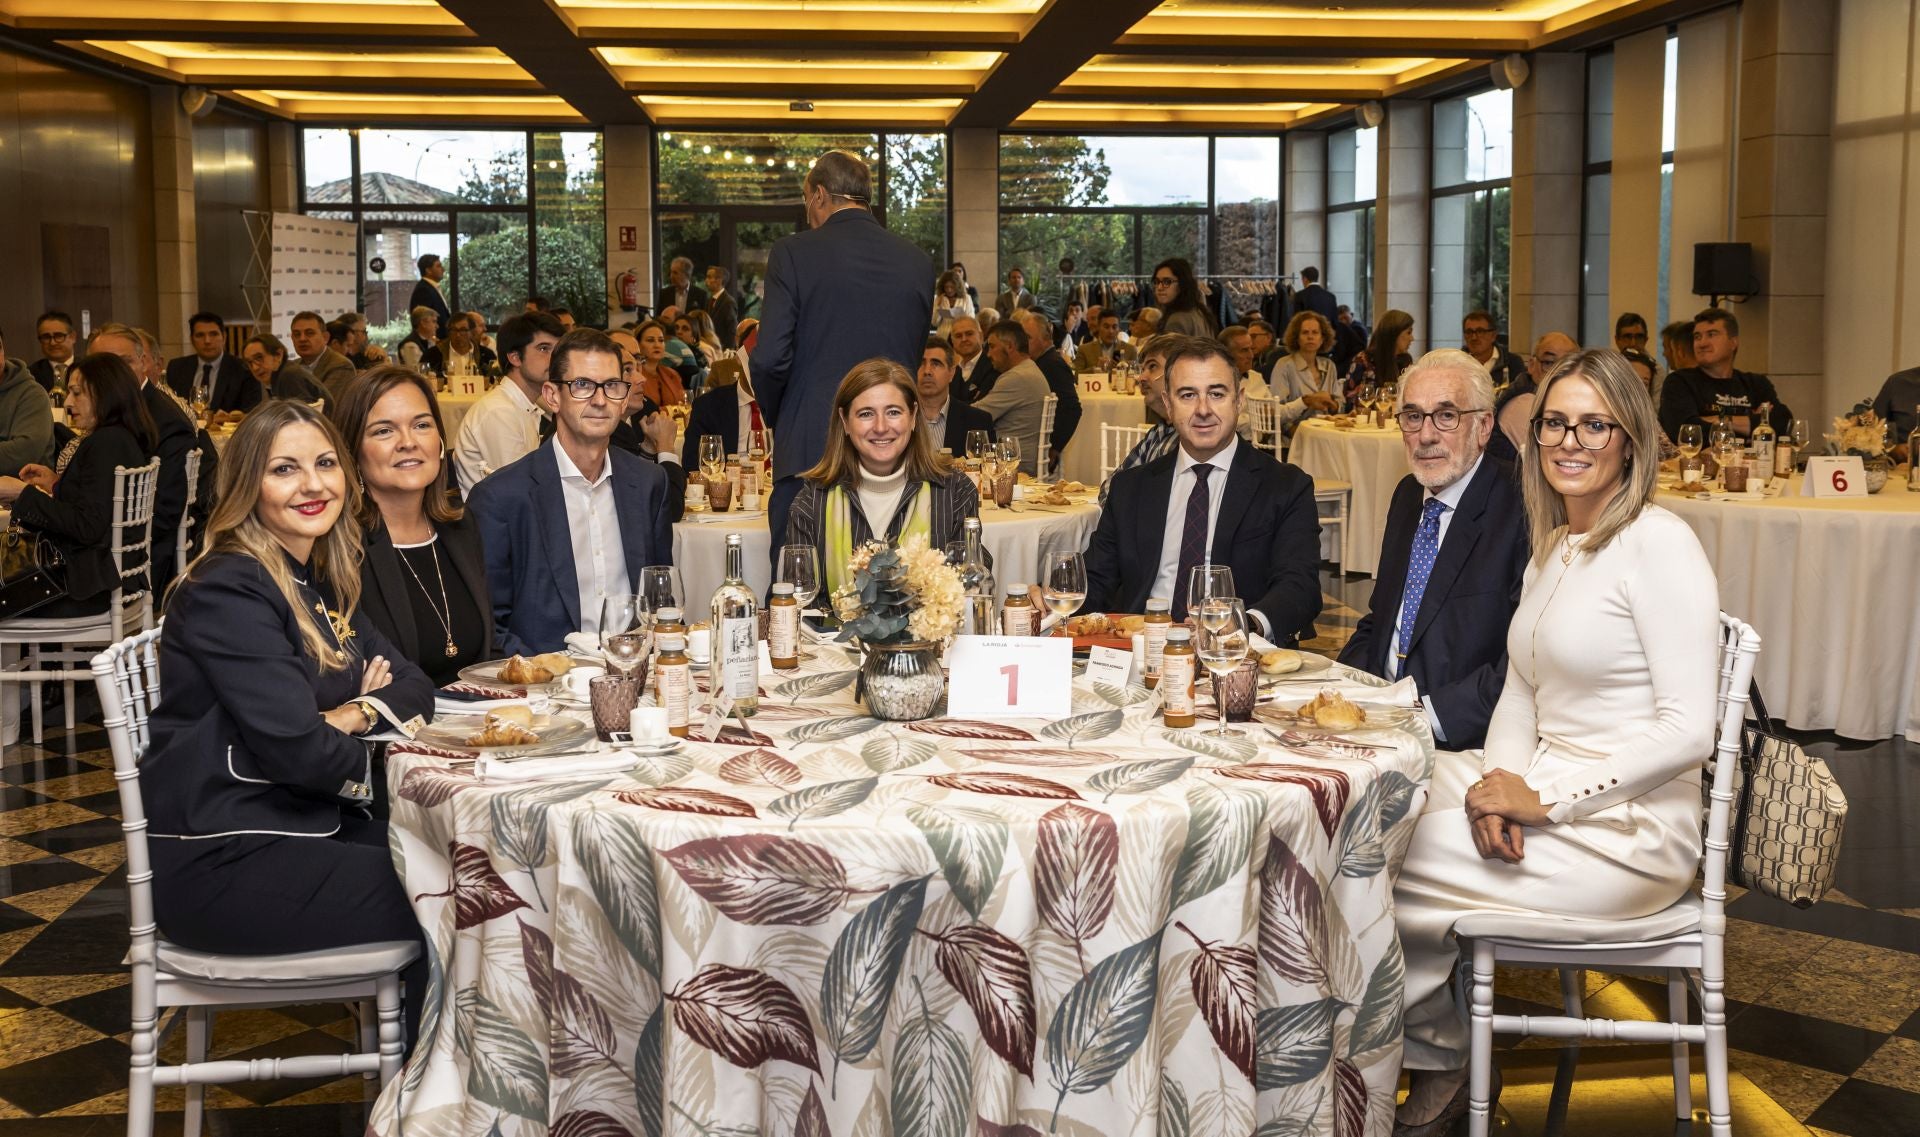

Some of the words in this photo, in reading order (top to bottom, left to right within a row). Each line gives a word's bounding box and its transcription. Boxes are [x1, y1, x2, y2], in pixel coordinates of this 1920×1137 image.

[462, 382, 475, 394] 11
[1083, 380, 1102, 392] 10
[1832, 469, 1848, 492] 6
[1000, 664, 1019, 705] 1
